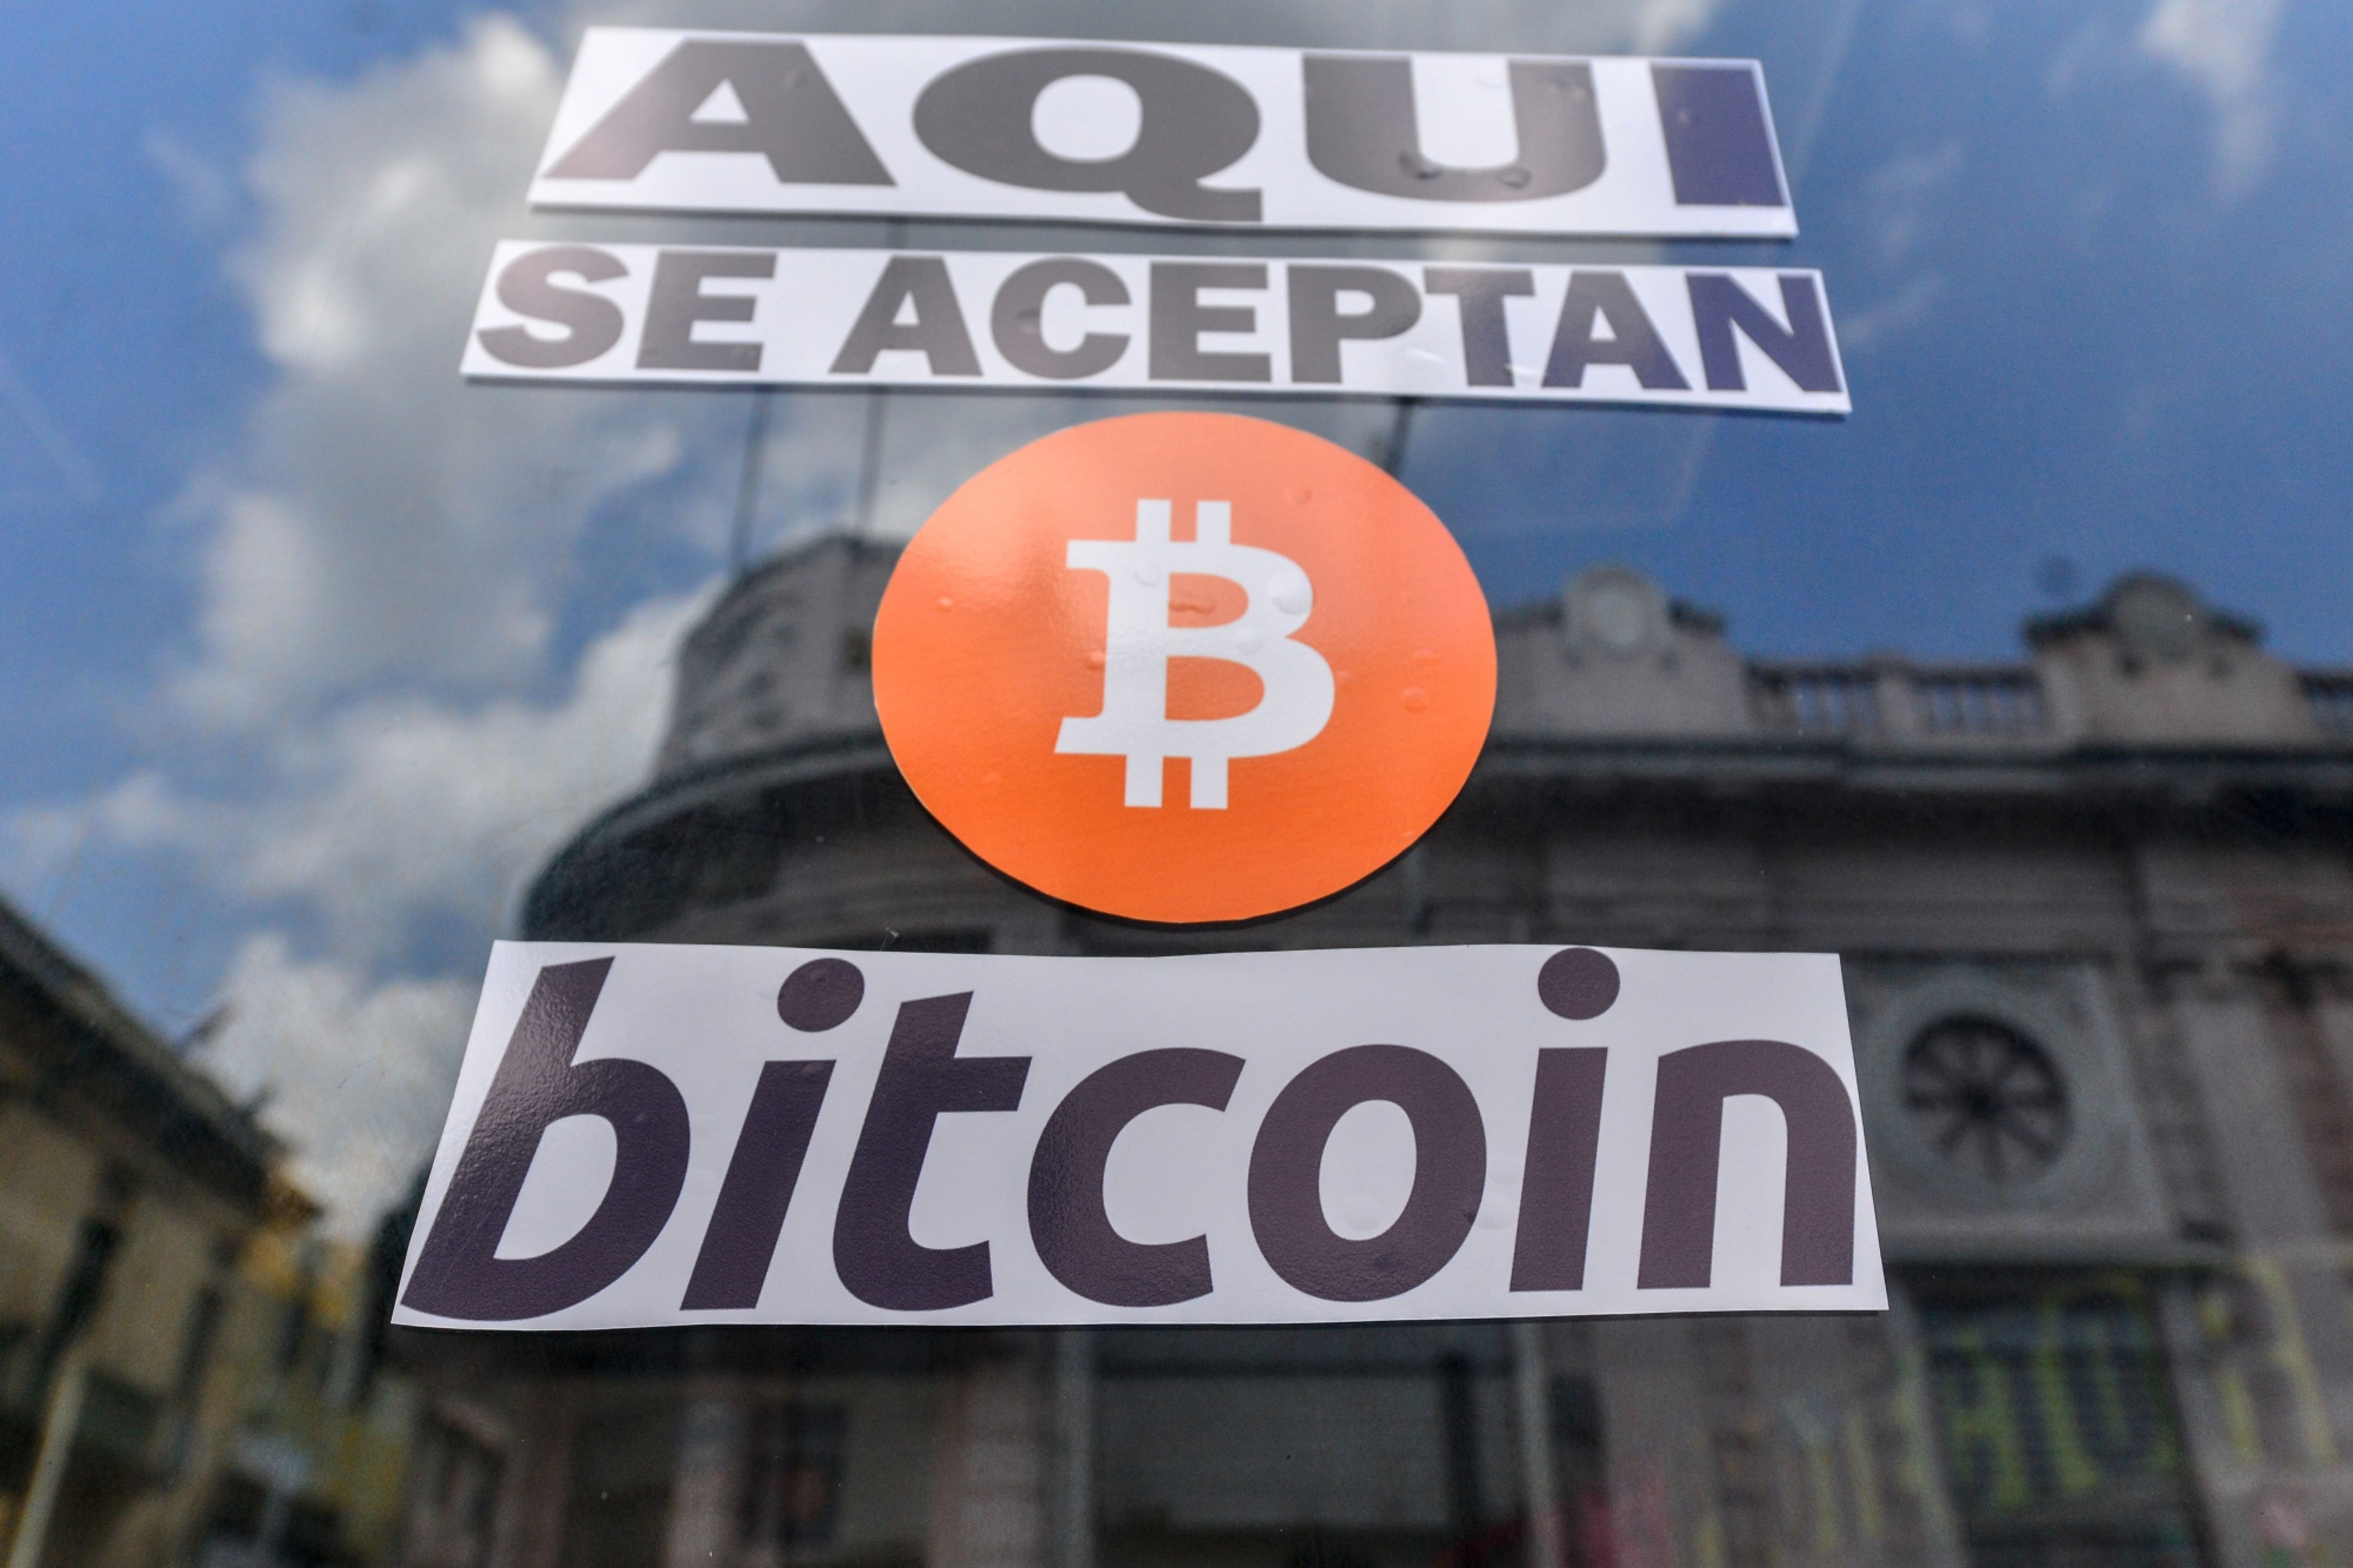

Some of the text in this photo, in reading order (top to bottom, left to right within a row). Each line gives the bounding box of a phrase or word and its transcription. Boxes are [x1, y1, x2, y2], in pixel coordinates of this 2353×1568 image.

[542, 39, 1787, 222] AQUI
[477, 245, 1842, 394] SE ACEPTAN
[400, 948, 1855, 1322] bitcoin
